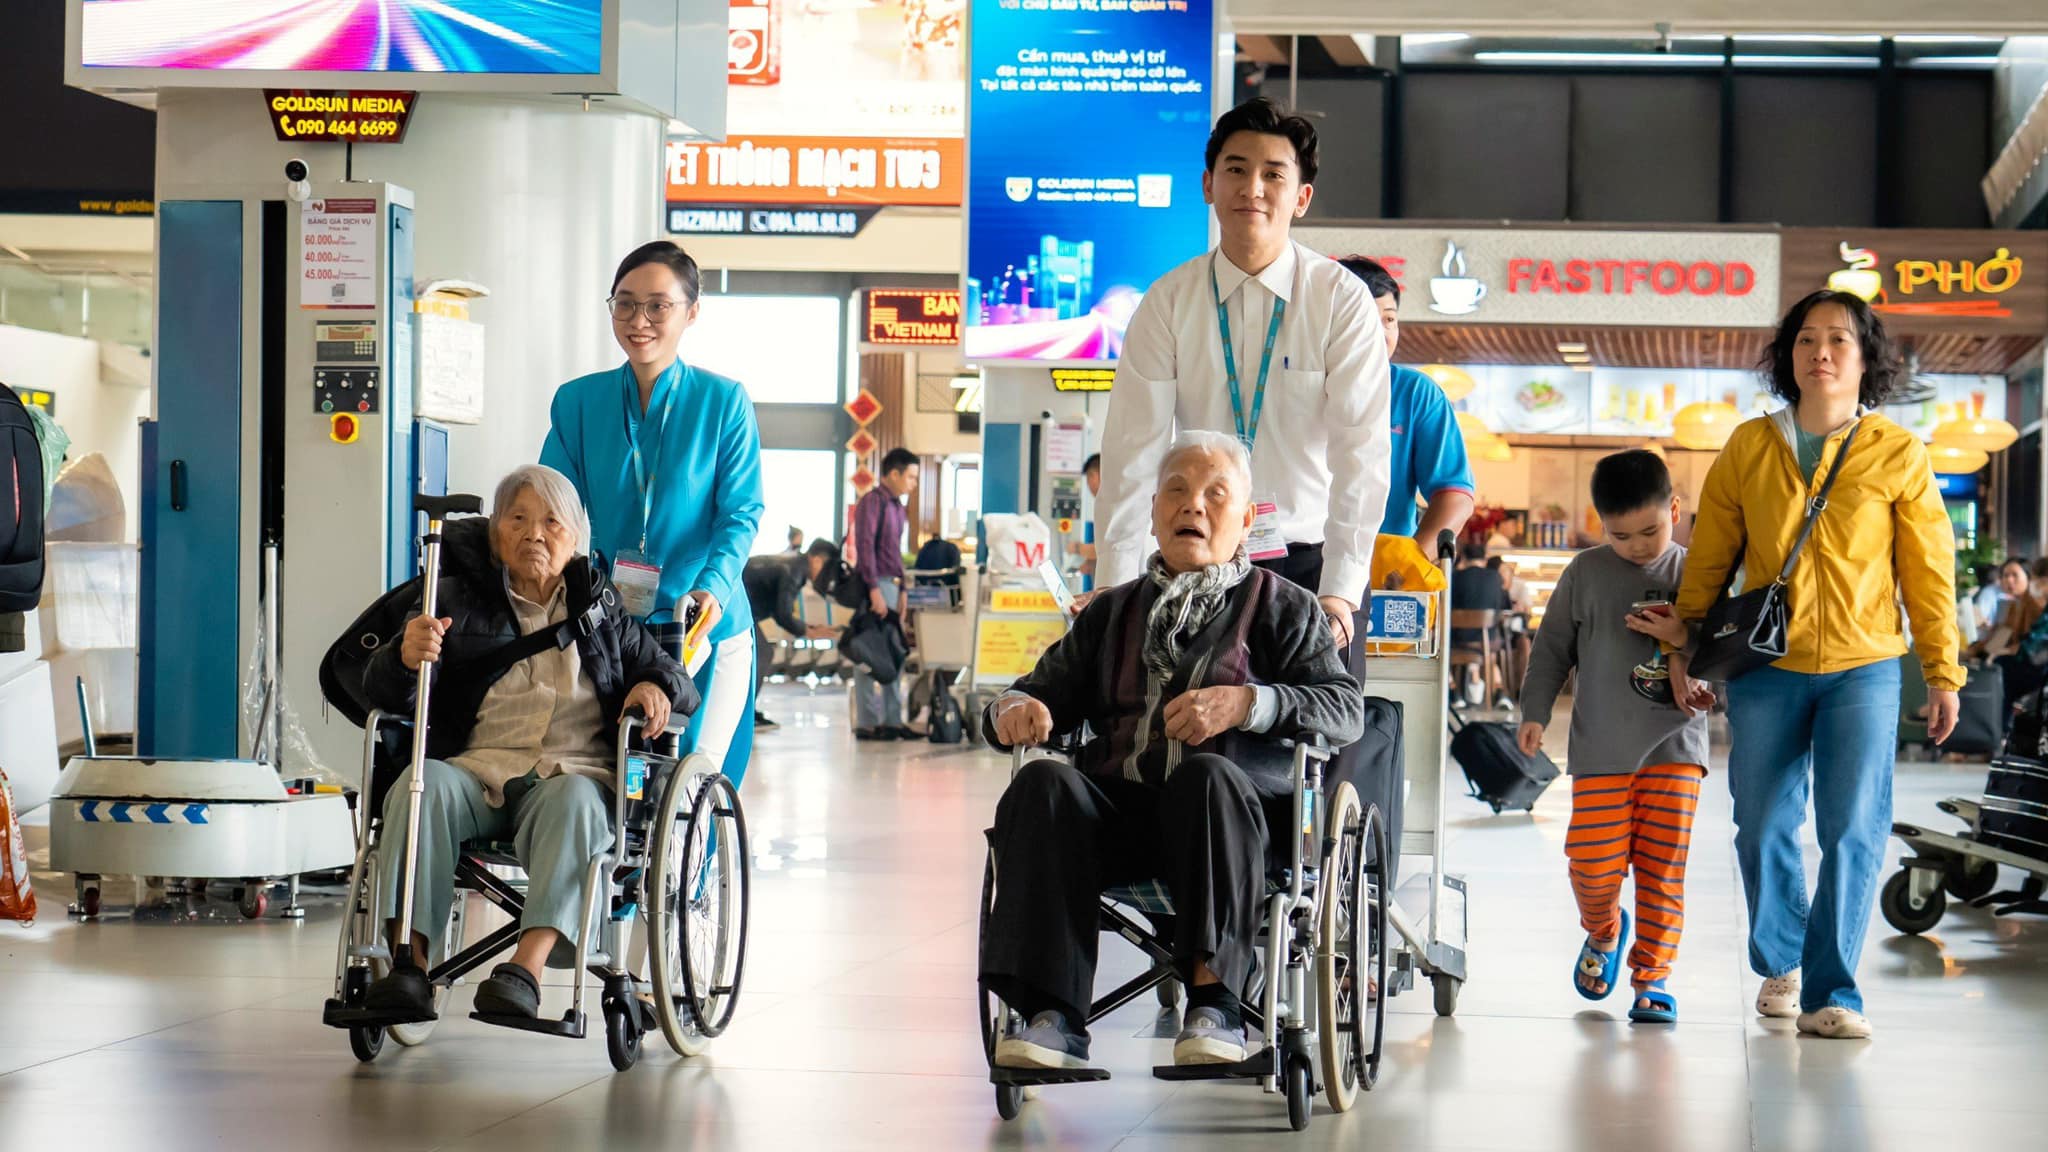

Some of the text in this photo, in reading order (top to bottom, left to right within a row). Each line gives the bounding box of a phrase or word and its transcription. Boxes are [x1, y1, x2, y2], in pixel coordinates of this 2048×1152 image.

[1051, 51, 1090, 64] mua,
[271, 96, 406, 113] GOLDSUN MEDIA
[296, 119, 398, 136] 090 464 6699
[670, 211, 743, 232] BIZMAN
[1506, 257, 1756, 297] FASTFOOD
[884, 321, 952, 338] VIETNAM
[1015, 540, 1045, 569] M
